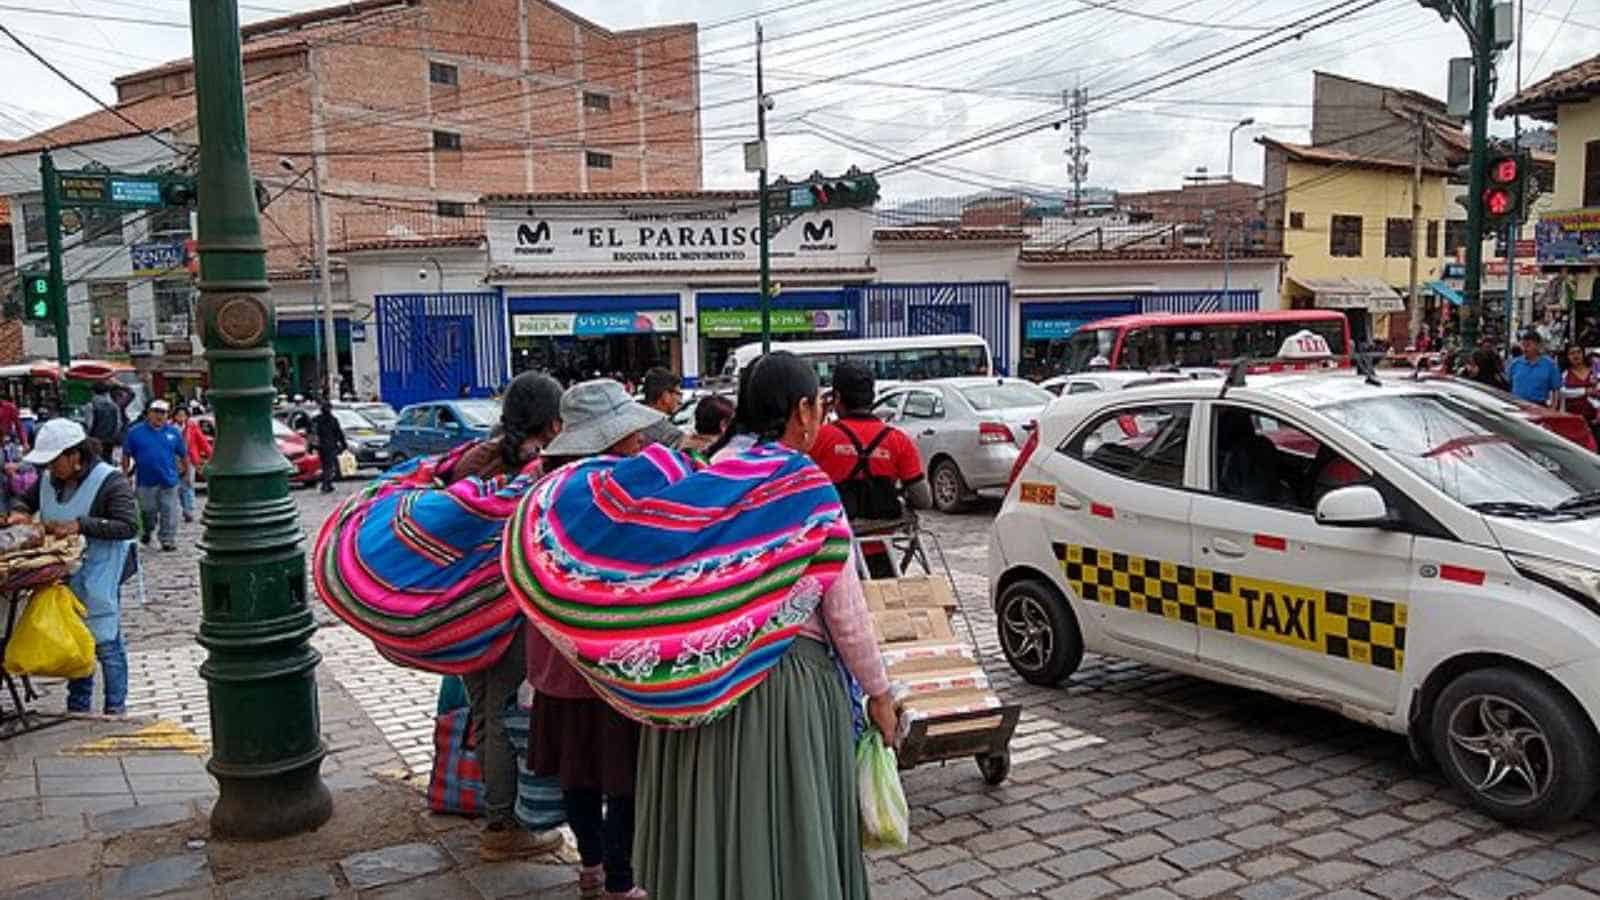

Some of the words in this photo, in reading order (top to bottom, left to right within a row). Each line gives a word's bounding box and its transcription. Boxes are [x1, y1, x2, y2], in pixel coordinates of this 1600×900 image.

[514, 246, 554, 255] movistar
[799, 243, 838, 251] movistar
[613, 251, 658, 263] ESQUINA
[659, 251, 678, 261] DEL
[680, 251, 746, 261] MOVIMIENTO
[1297, 340, 1327, 351] TAXI
[1239, 586, 1317, 642] TAXI
